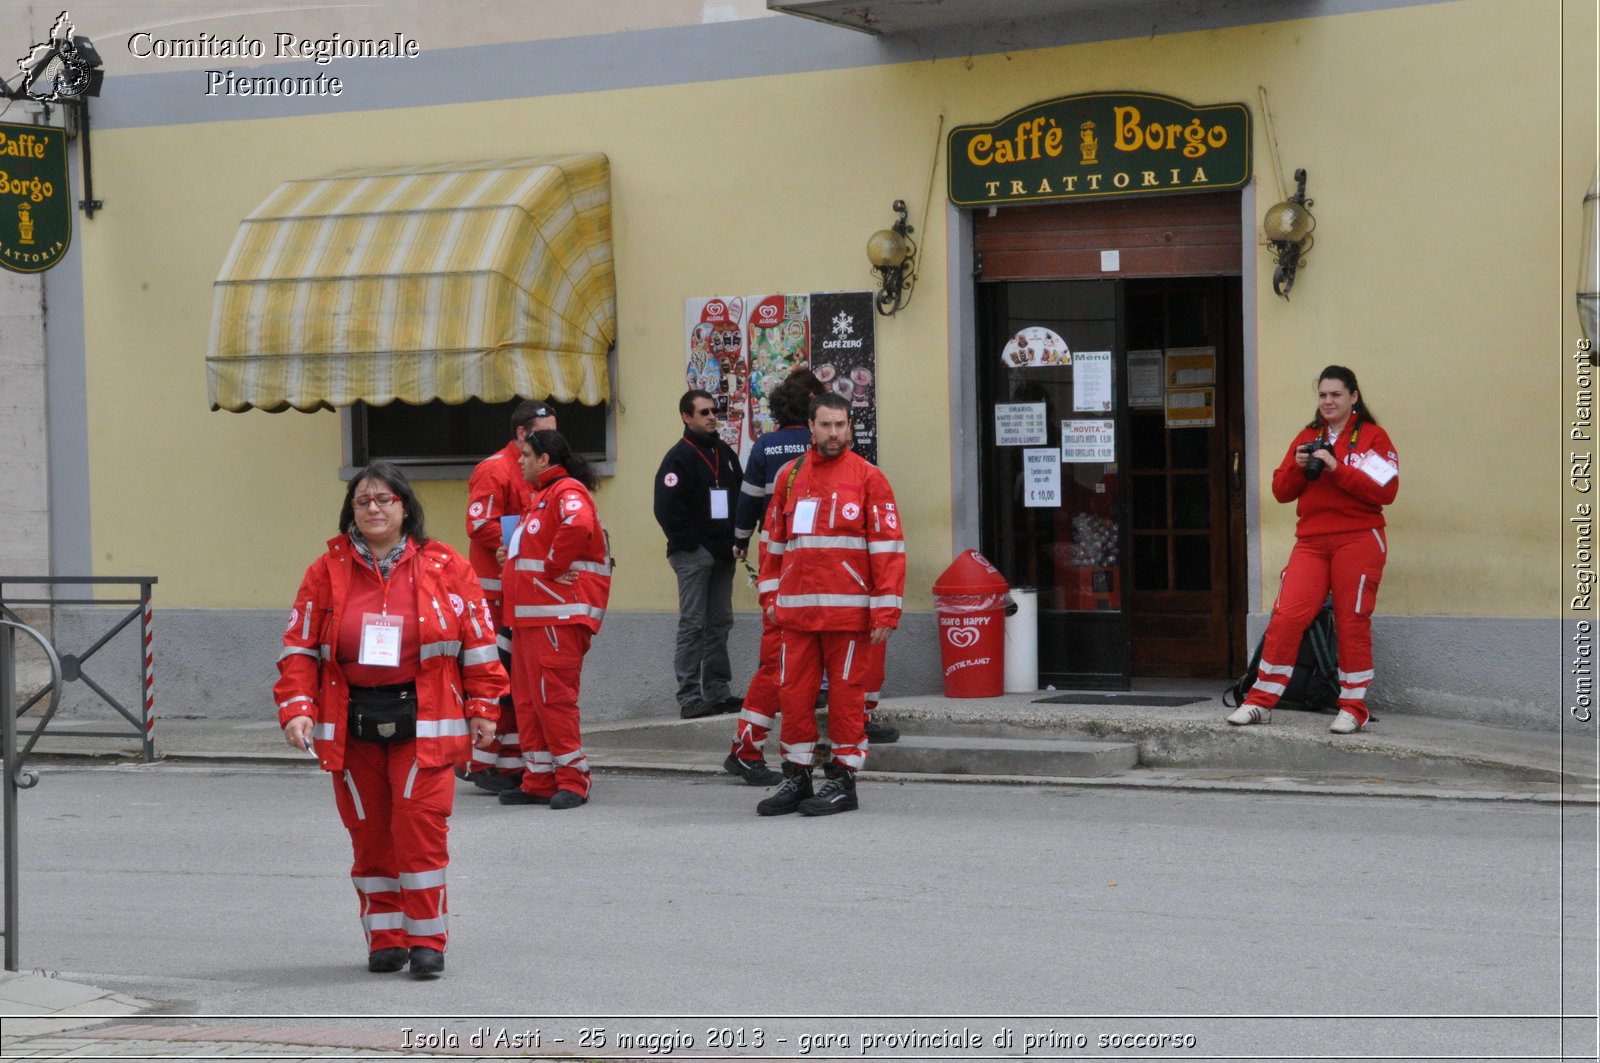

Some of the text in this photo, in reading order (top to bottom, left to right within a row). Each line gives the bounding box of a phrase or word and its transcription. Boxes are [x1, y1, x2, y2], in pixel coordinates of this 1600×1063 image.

[967, 105, 1228, 167] Caffè Borgo
[985, 167, 1209, 197] TRATTORIA
[764, 446, 783, 456] CROCE
[784, 444, 805, 454] ROSSA
[1038, 490, 1055, 503] 10,00
